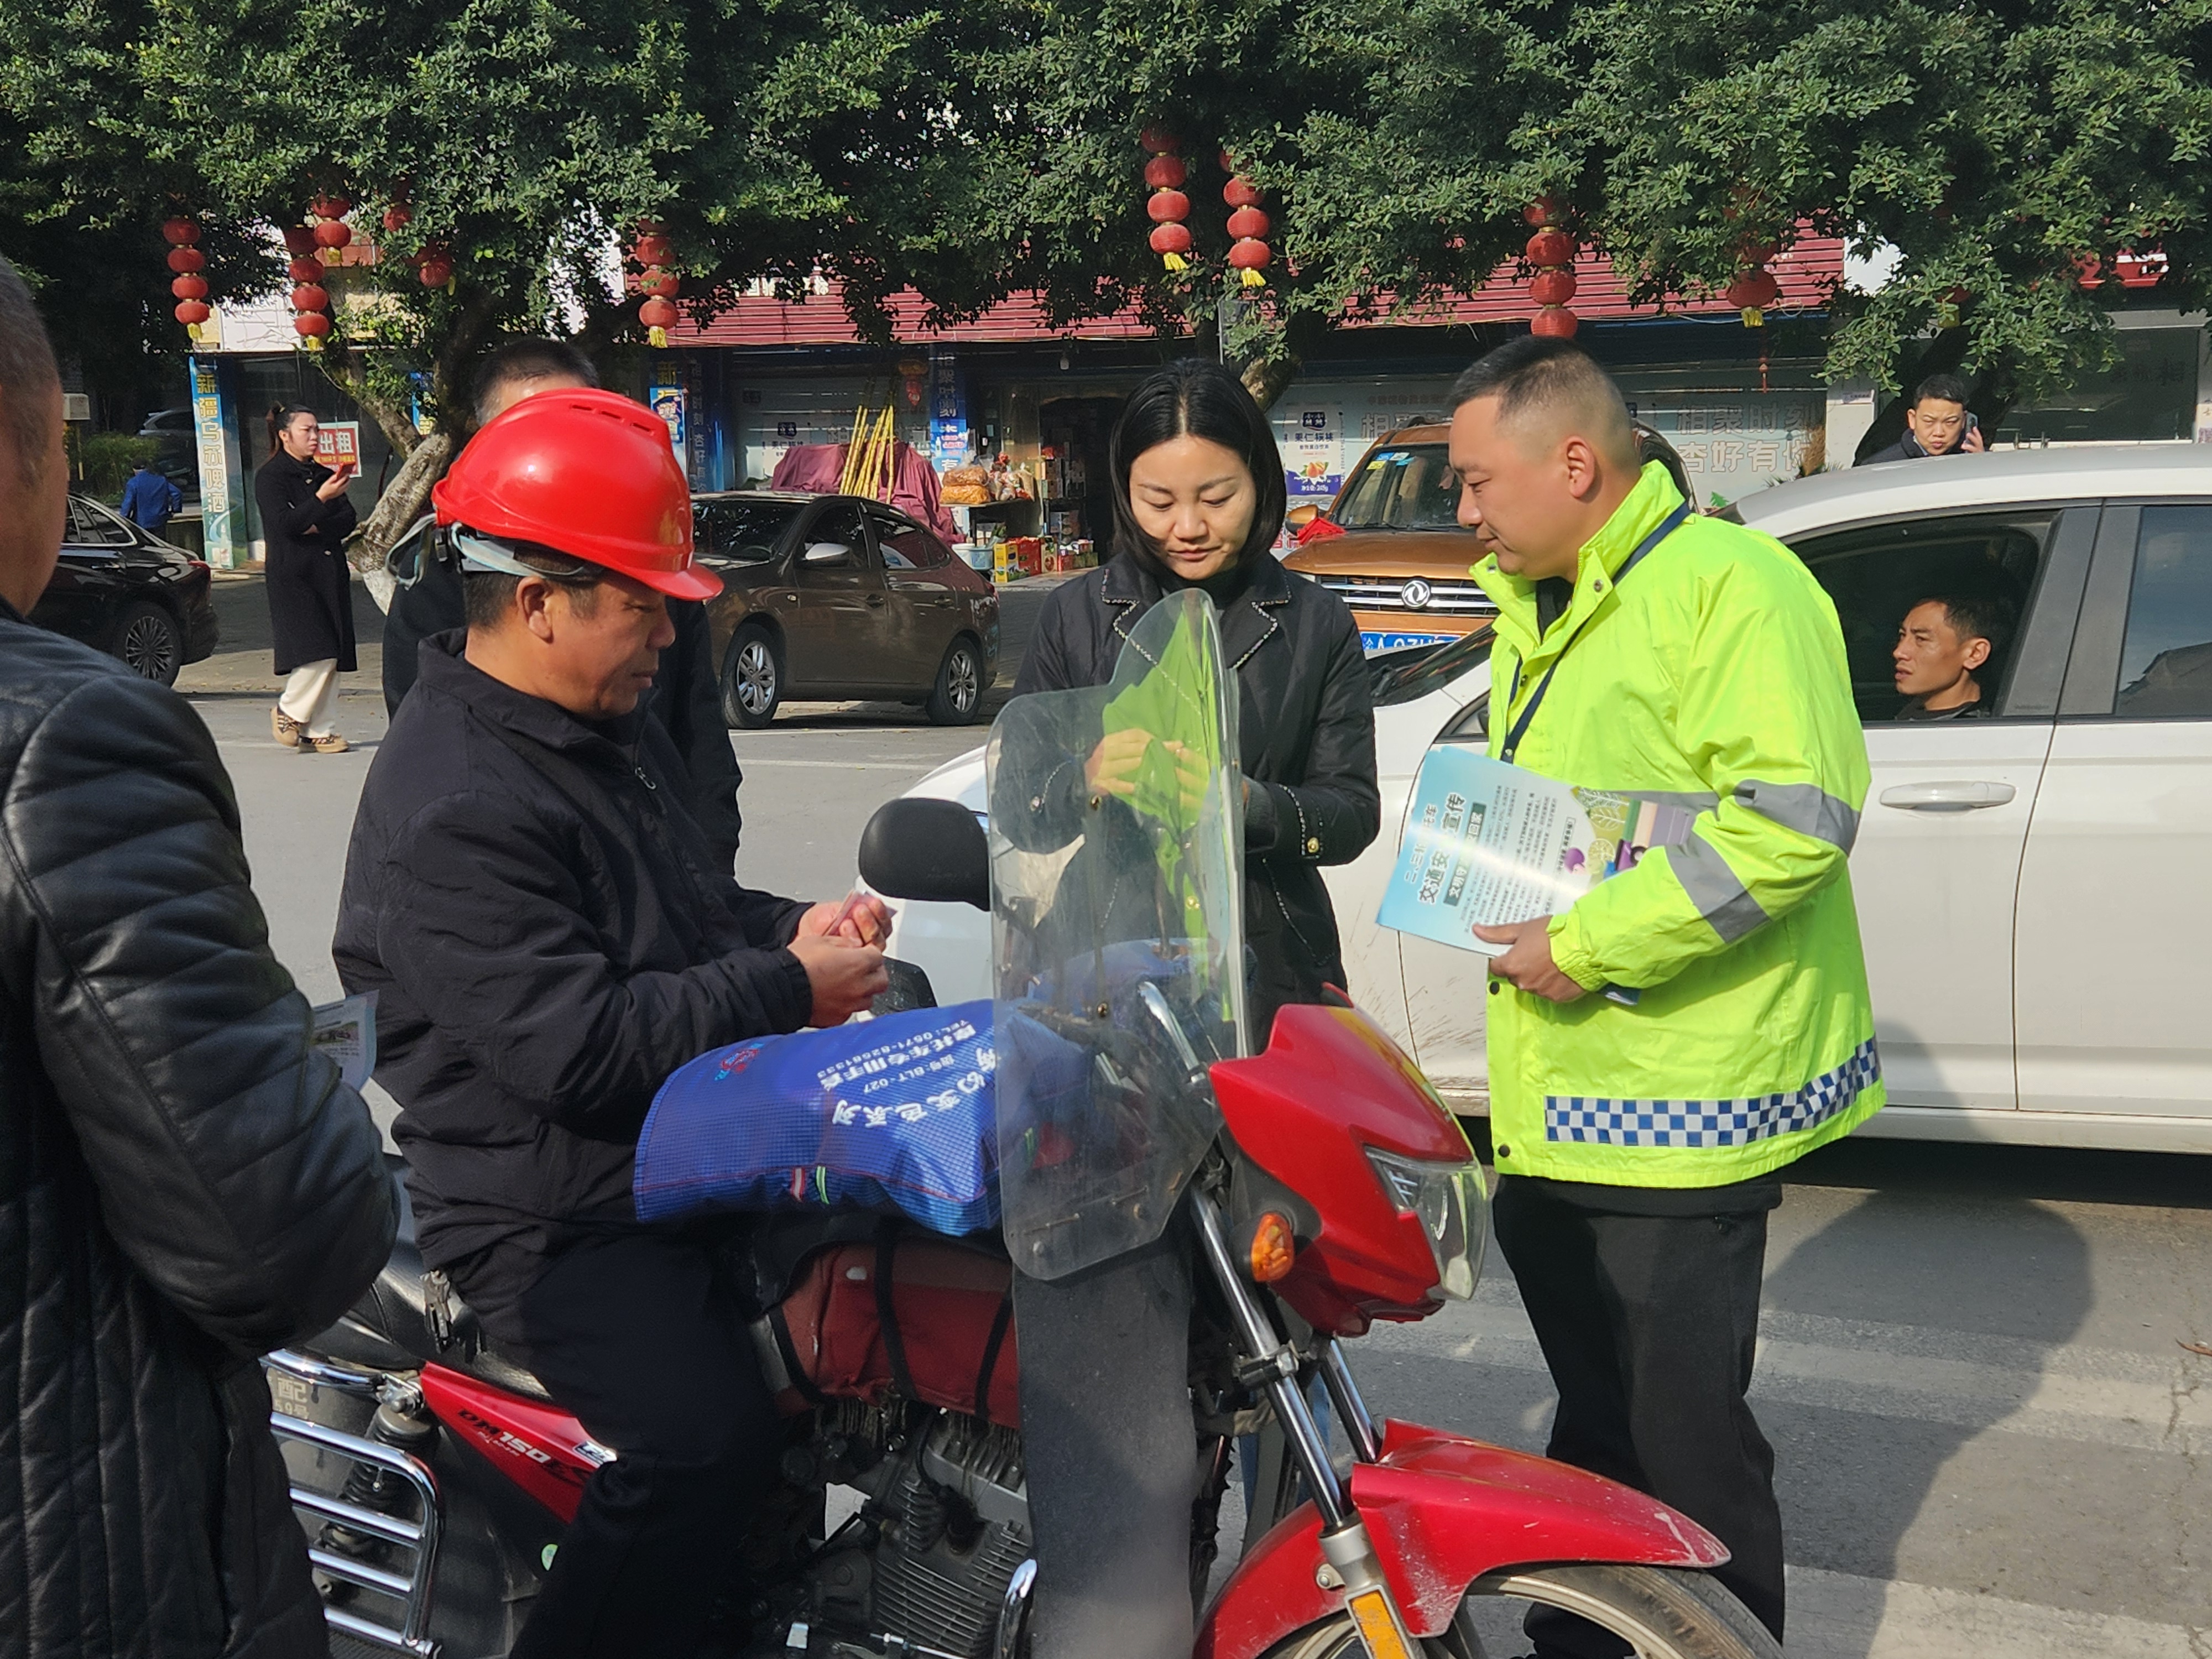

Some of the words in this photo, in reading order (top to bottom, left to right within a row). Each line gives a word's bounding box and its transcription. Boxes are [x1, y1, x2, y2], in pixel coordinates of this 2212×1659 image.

[196, 374, 226, 514] 新疆乌苏啤酒
[320, 431, 354, 454] 出租
[1676, 403, 1819, 435] 相聚时刻
[1419, 792, 1466, 904] 交通安宣传
